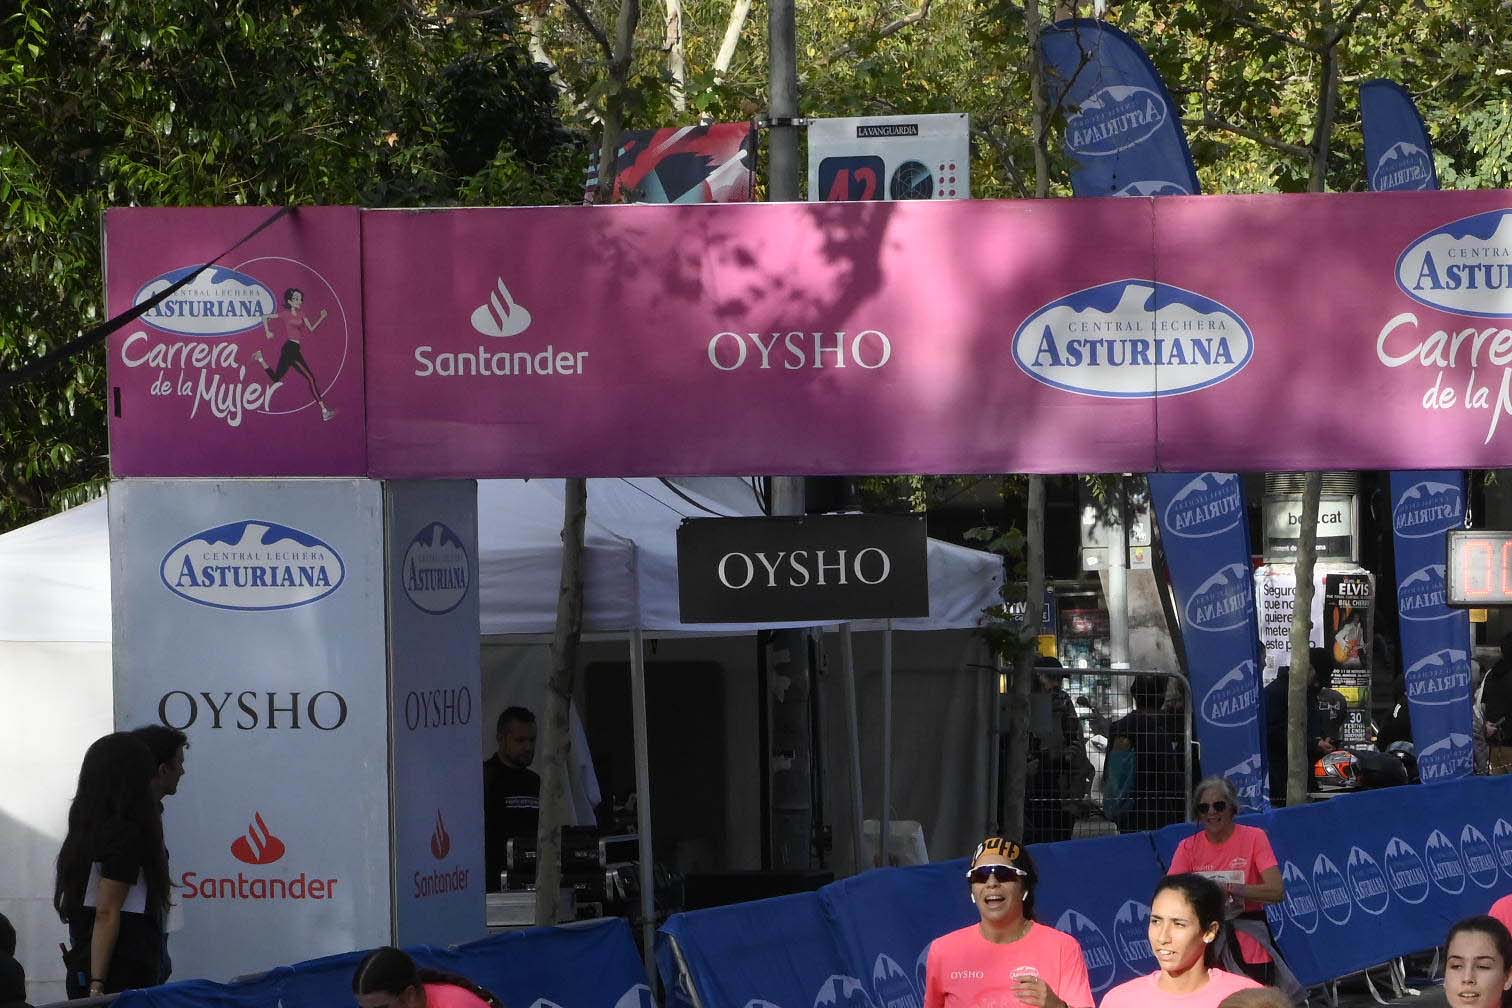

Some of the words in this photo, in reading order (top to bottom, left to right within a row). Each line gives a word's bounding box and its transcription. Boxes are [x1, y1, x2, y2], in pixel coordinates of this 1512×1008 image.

[144, 290, 263, 318] ASTURIANA
[172, 288, 211, 297] ENTRAL
[1068, 321, 1143, 332] CENTRAL
[1151, 319, 1227, 332] LECHERA
[121, 331, 239, 368] Carrera
[414, 344, 590, 378] Santander
[707, 330, 892, 371] OYSHO
[1031, 324, 1235, 367] ASTURIANA
[151, 370, 172, 396] de
[177, 370, 192, 396] la
[190, 365, 283, 427] Mujer
[1422, 370, 1457, 409] de
[1464, 369, 1489, 409] la
[175, 554, 333, 588] ASTURIANA
[203, 552, 260, 561] CENTRAL
[267, 552, 325, 561] LECHERA
[717, 546, 891, 592] OYSHO
[407, 557, 466, 591] ASTURIANA
[1339, 583, 1369, 596] ELVIS
[157, 690, 348, 731] OYSHO
[405, 685, 472, 731] OYSHO
[1350, 713, 1361, 723] 30
[180, 870, 338, 902] Santander
[413, 867, 470, 899] Santander
[951, 970, 984, 980] OYSHO
